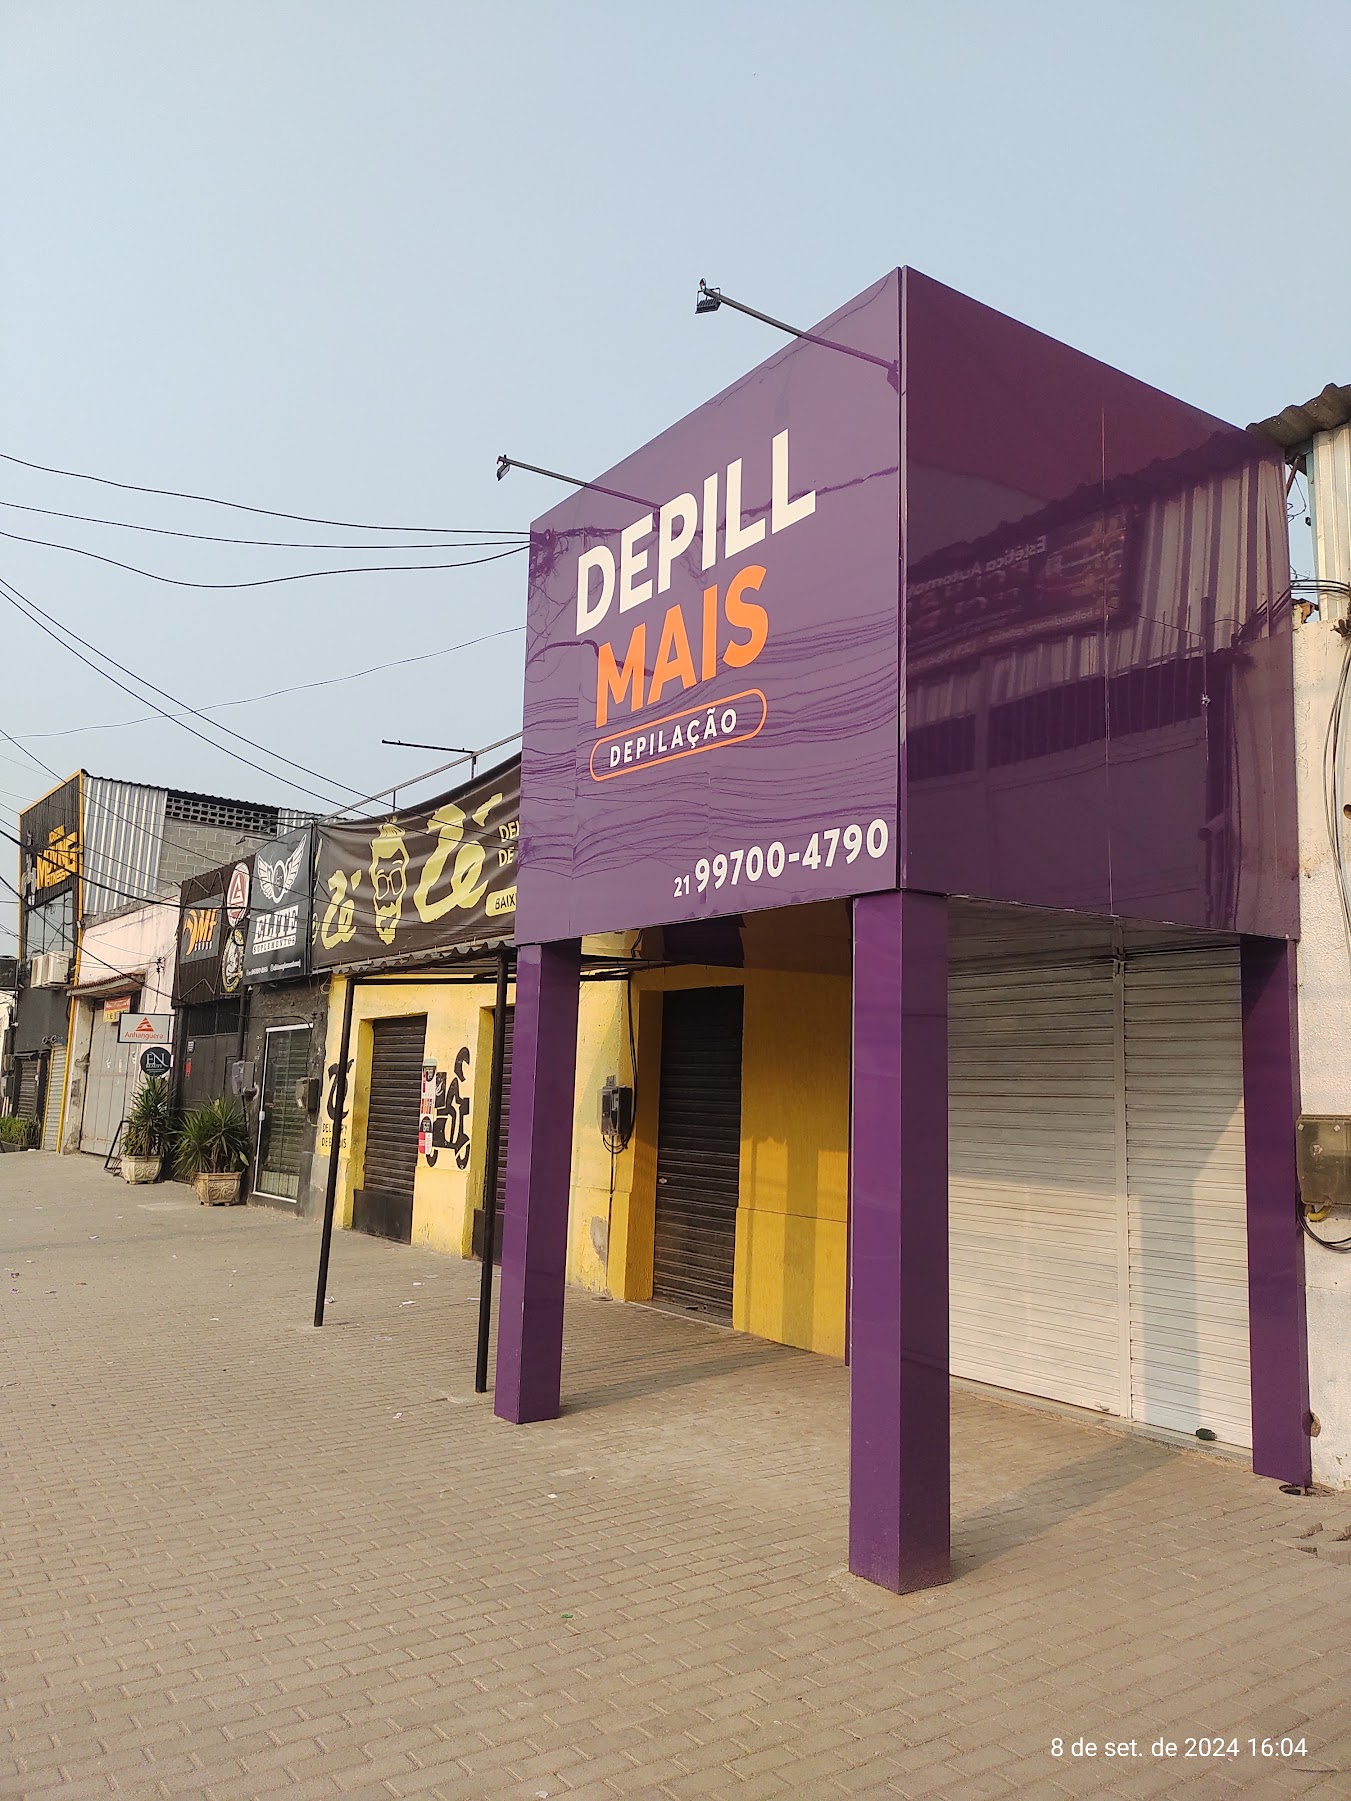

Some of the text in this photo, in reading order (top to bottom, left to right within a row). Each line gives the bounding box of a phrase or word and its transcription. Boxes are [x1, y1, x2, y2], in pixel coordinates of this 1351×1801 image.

[575, 428, 816, 636] DEPILL
[594, 564, 769, 729] MAIS
[609, 707, 737, 769] DEPILAÇÃO
[498, 846, 515, 868] DE
[673, 818, 889, 898] 21 99700-4790
[253, 904, 299, 944] ELITE
[495, 893, 516, 911] BAIX
[124, 1031, 164, 1040] Anhanguera
